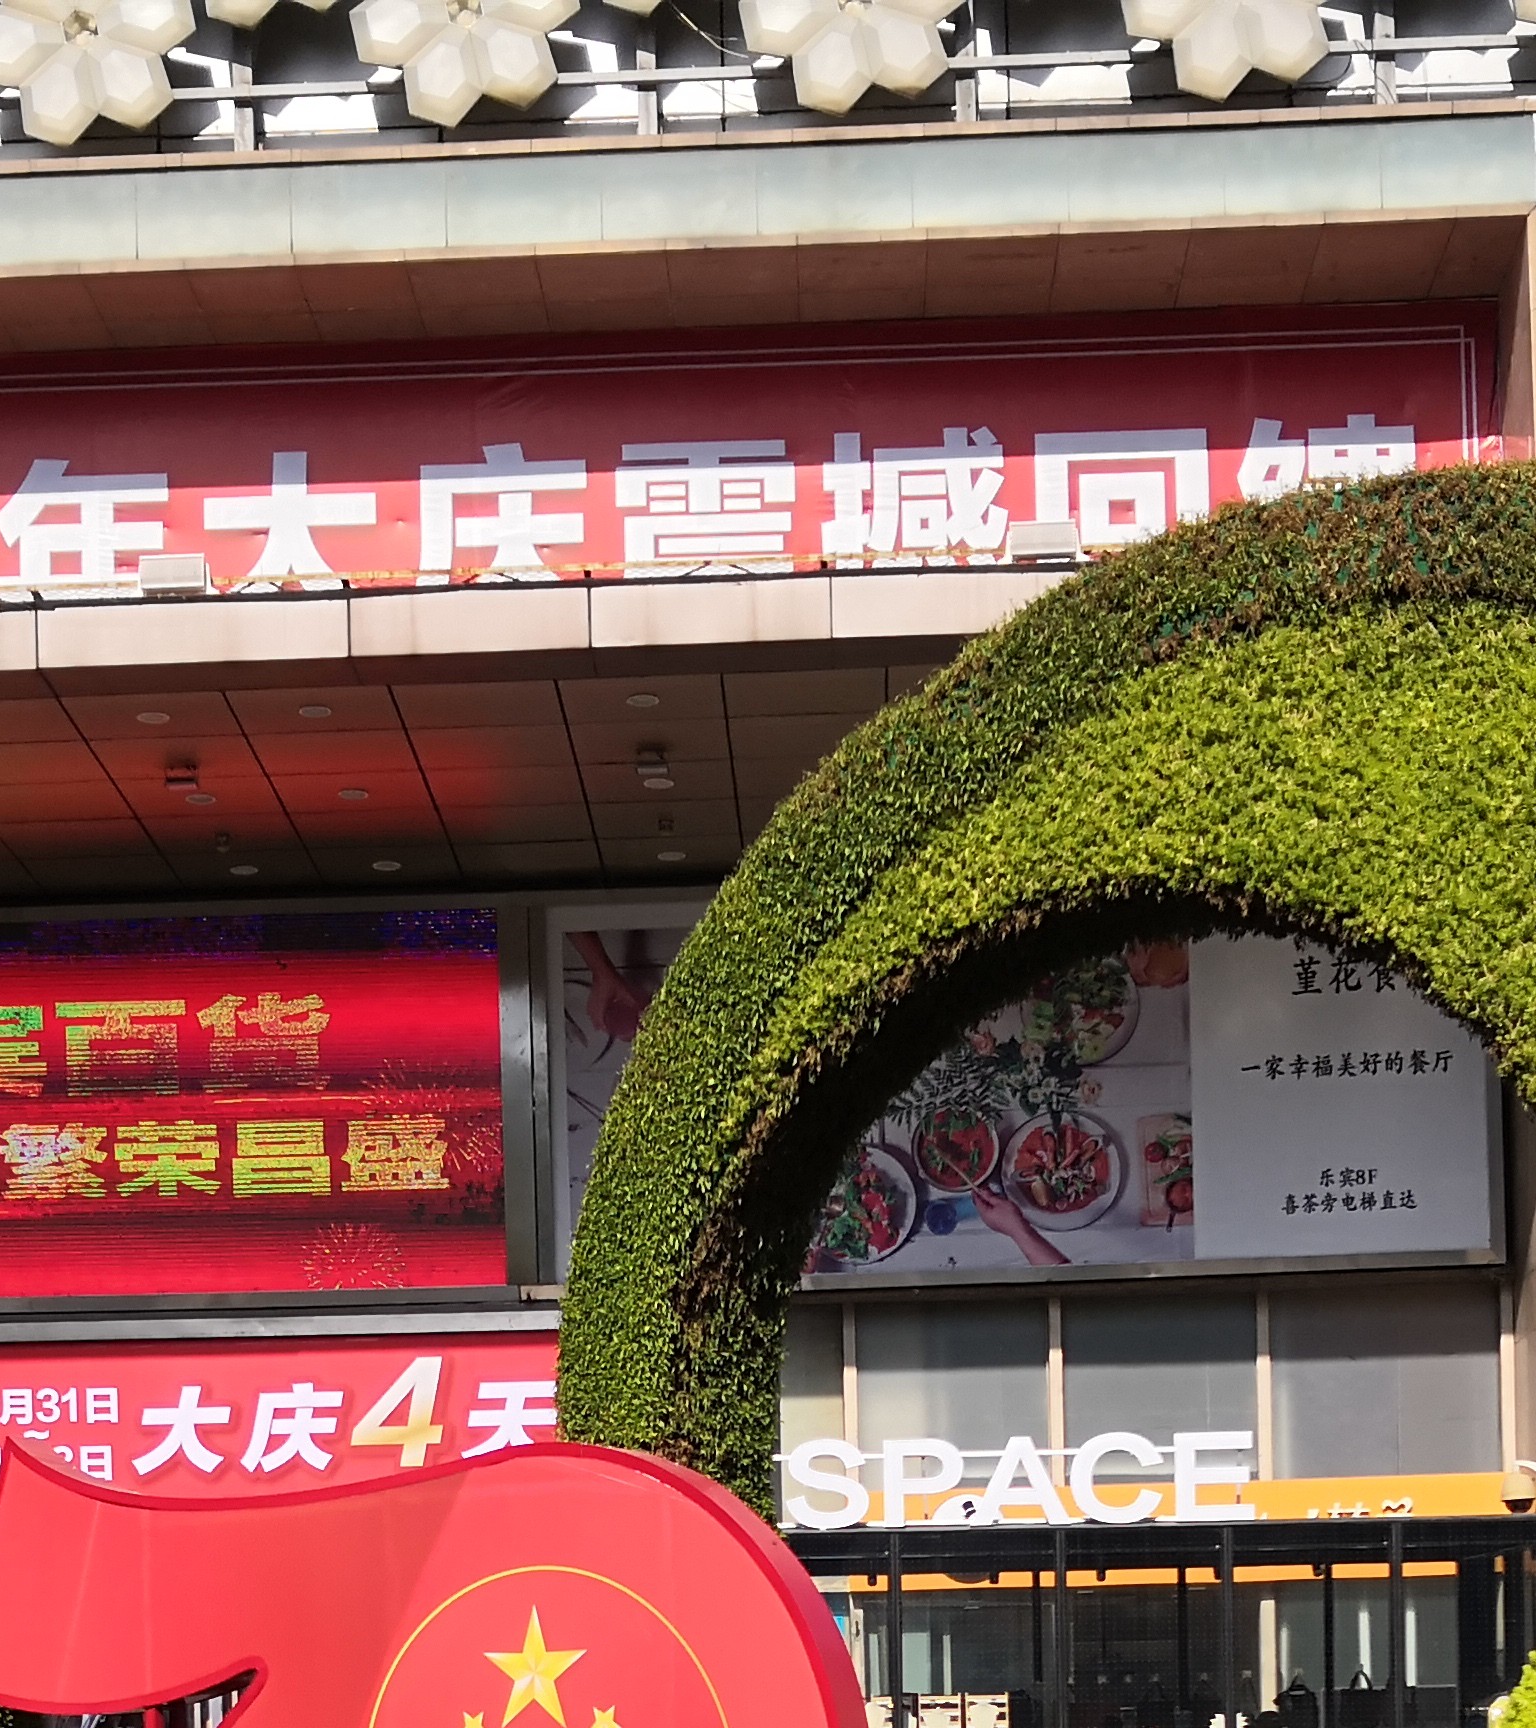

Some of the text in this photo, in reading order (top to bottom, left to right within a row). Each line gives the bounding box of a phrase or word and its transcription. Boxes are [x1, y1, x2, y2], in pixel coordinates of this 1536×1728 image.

[1241, 1049, 1454, 1080] 一家幸福美好的餐厅
[1320, 1167, 1378, 1189] 乐宾8F
[1281, 1190, 1418, 1216] 喜茶旁电梯直达
[131, 1355, 558, 1477] 大庆4天
[785, 1430, 1256, 1530] SPACE
